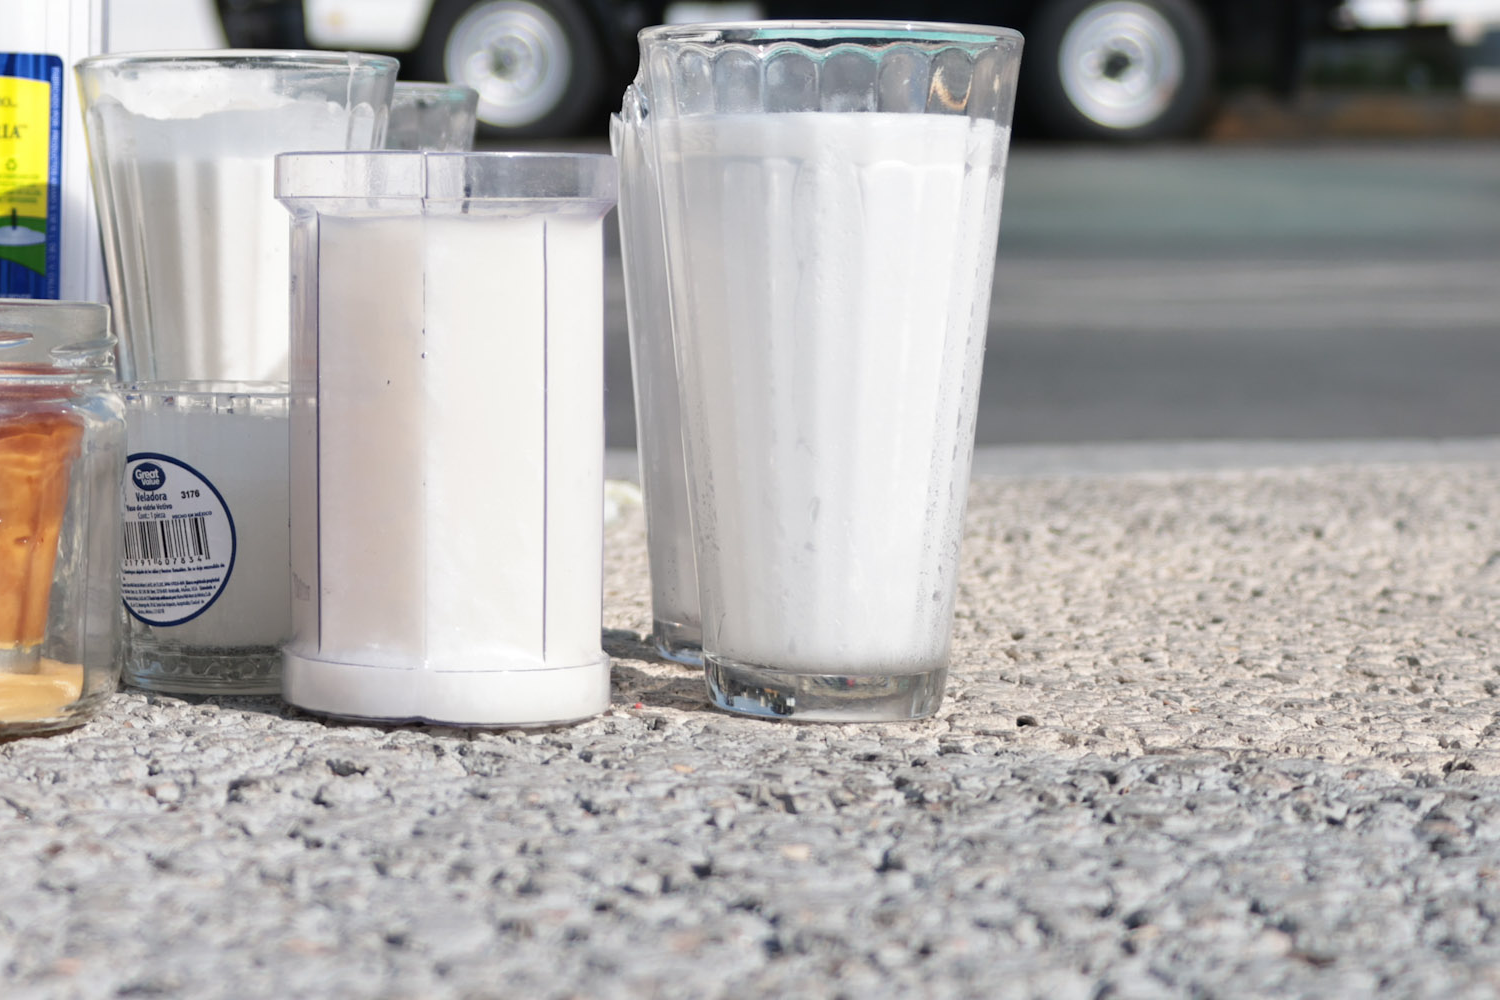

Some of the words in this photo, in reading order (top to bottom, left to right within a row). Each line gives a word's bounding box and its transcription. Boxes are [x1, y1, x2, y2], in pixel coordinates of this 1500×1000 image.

[135, 469, 160, 480] Great
[142, 478, 161, 486] Value
[135, 490, 168, 502] Veladora
[180, 489, 200, 499] 3176
